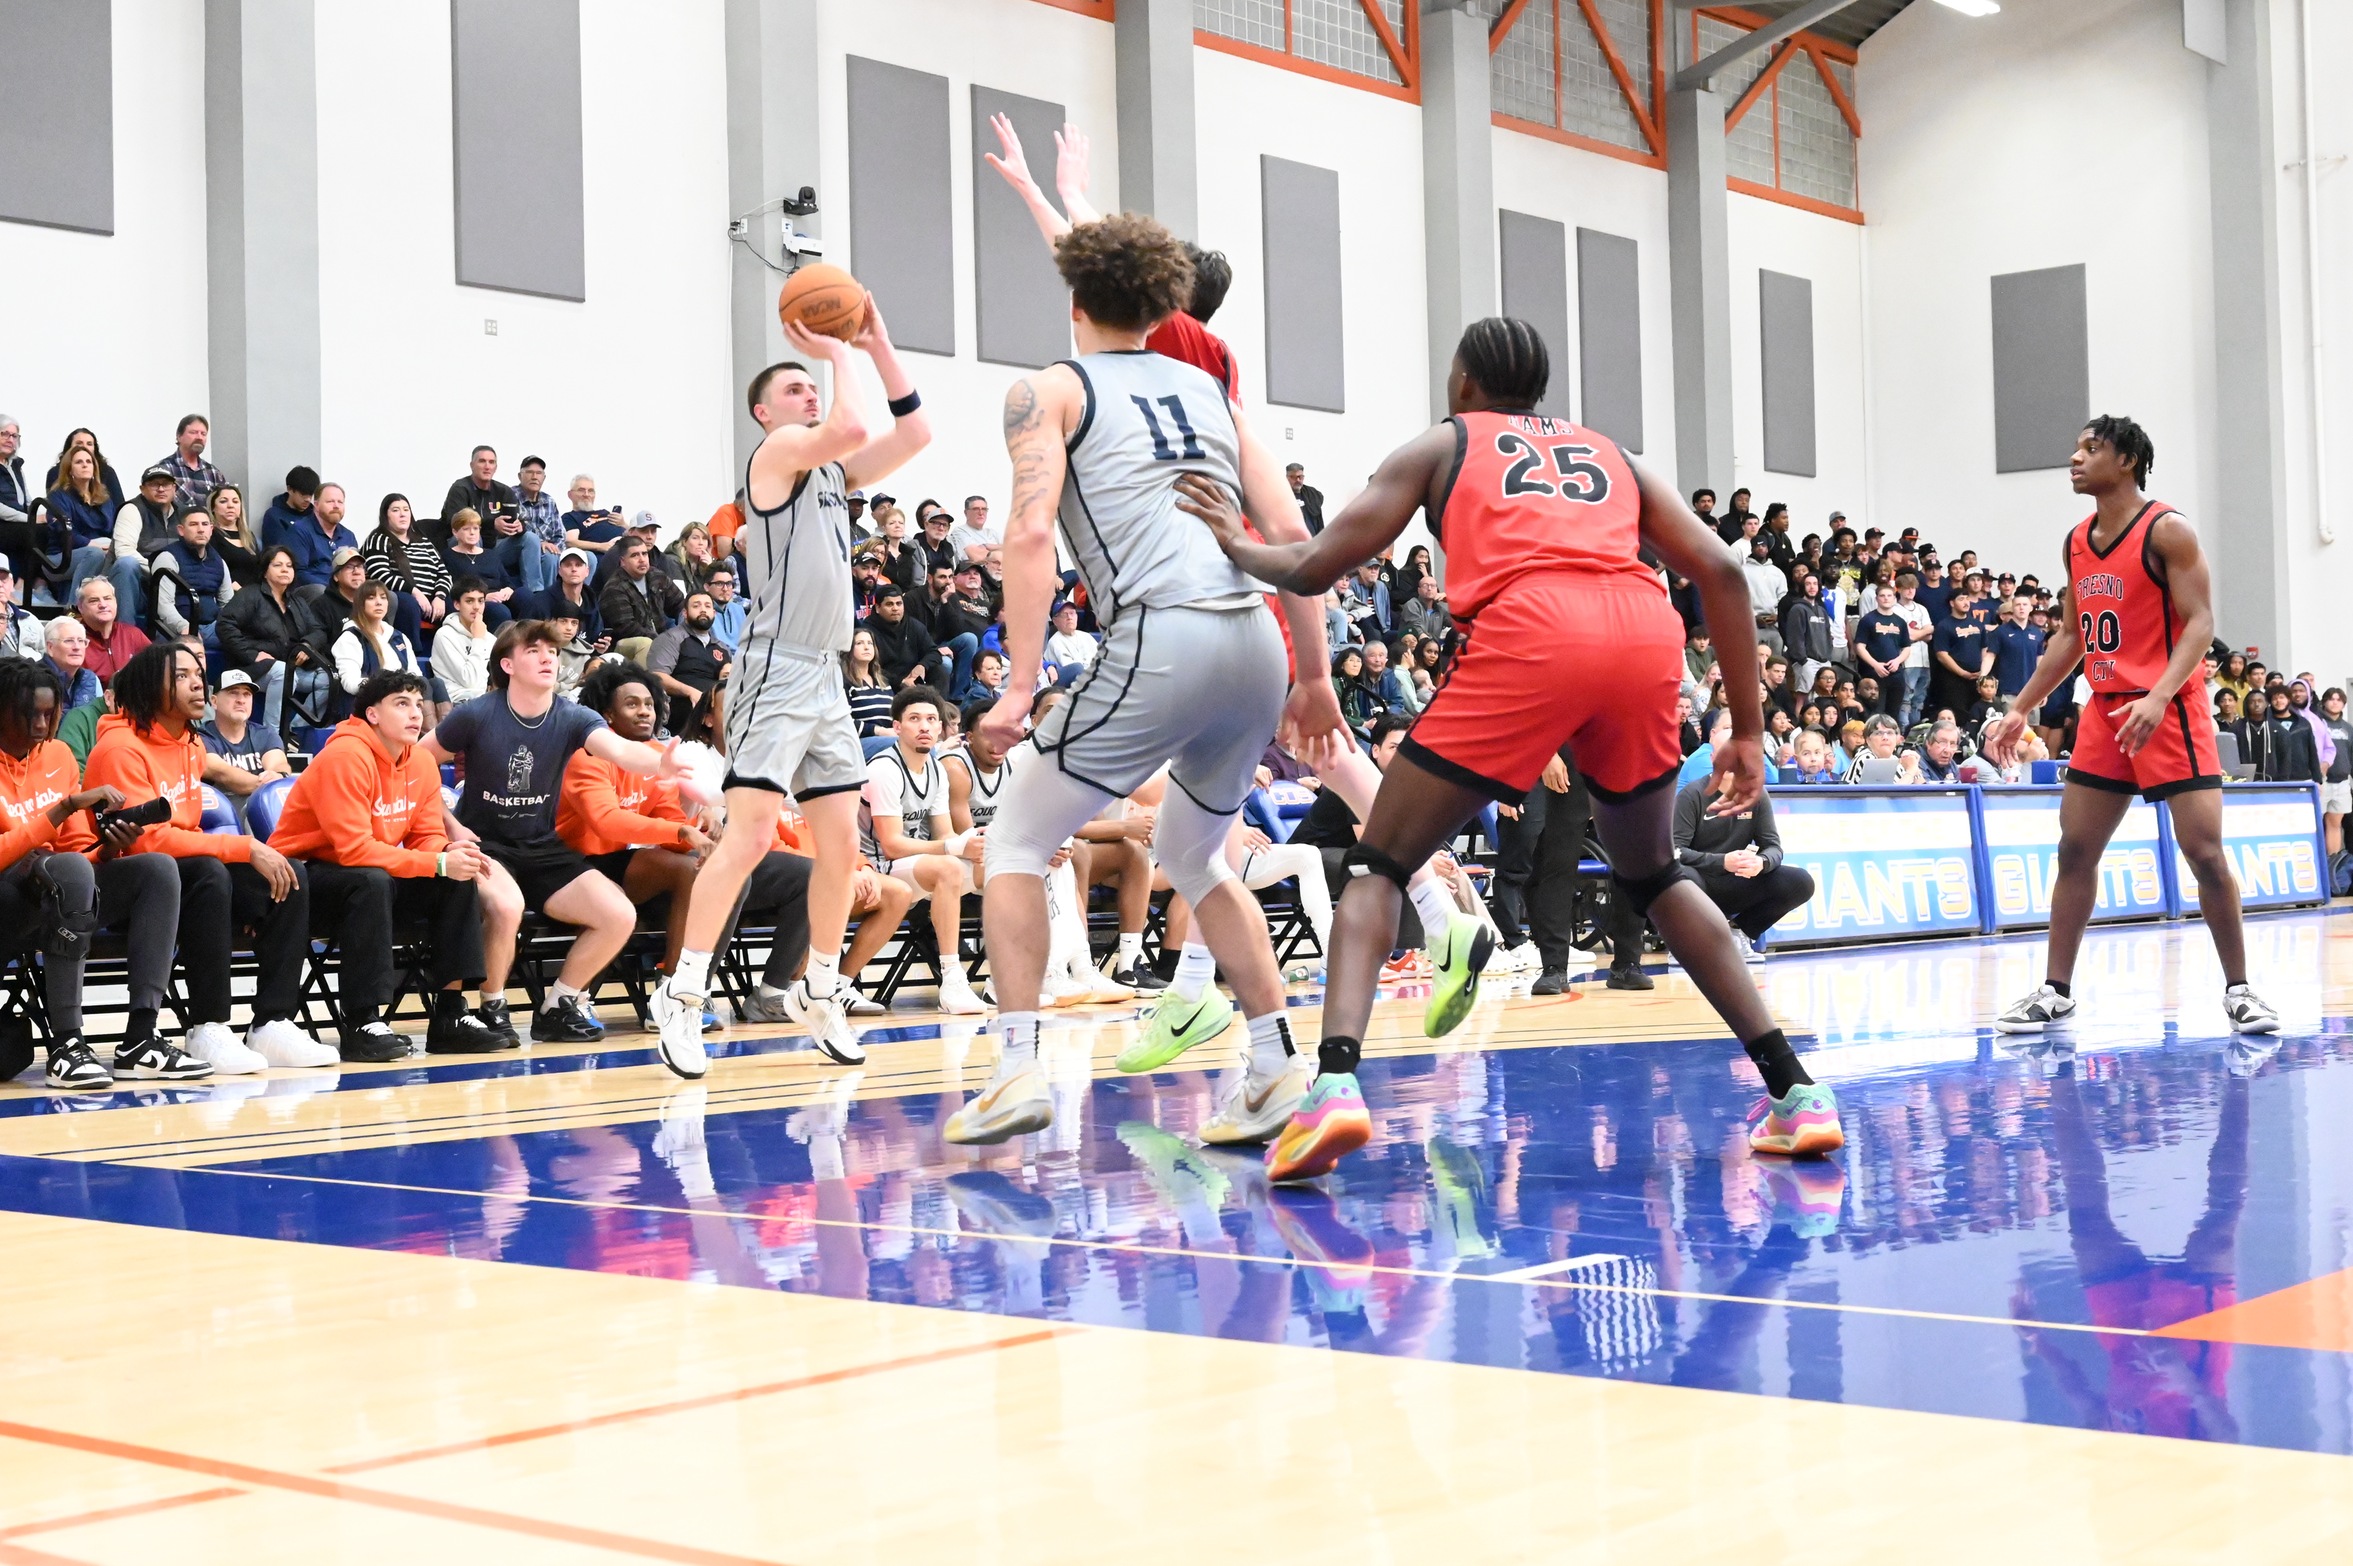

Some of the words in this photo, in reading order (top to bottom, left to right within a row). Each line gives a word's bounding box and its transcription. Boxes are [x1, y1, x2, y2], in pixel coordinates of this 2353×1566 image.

[1129, 394, 1206, 460] 11
[1495, 431, 1612, 504] 25
[2081, 610, 2121, 654] 20
